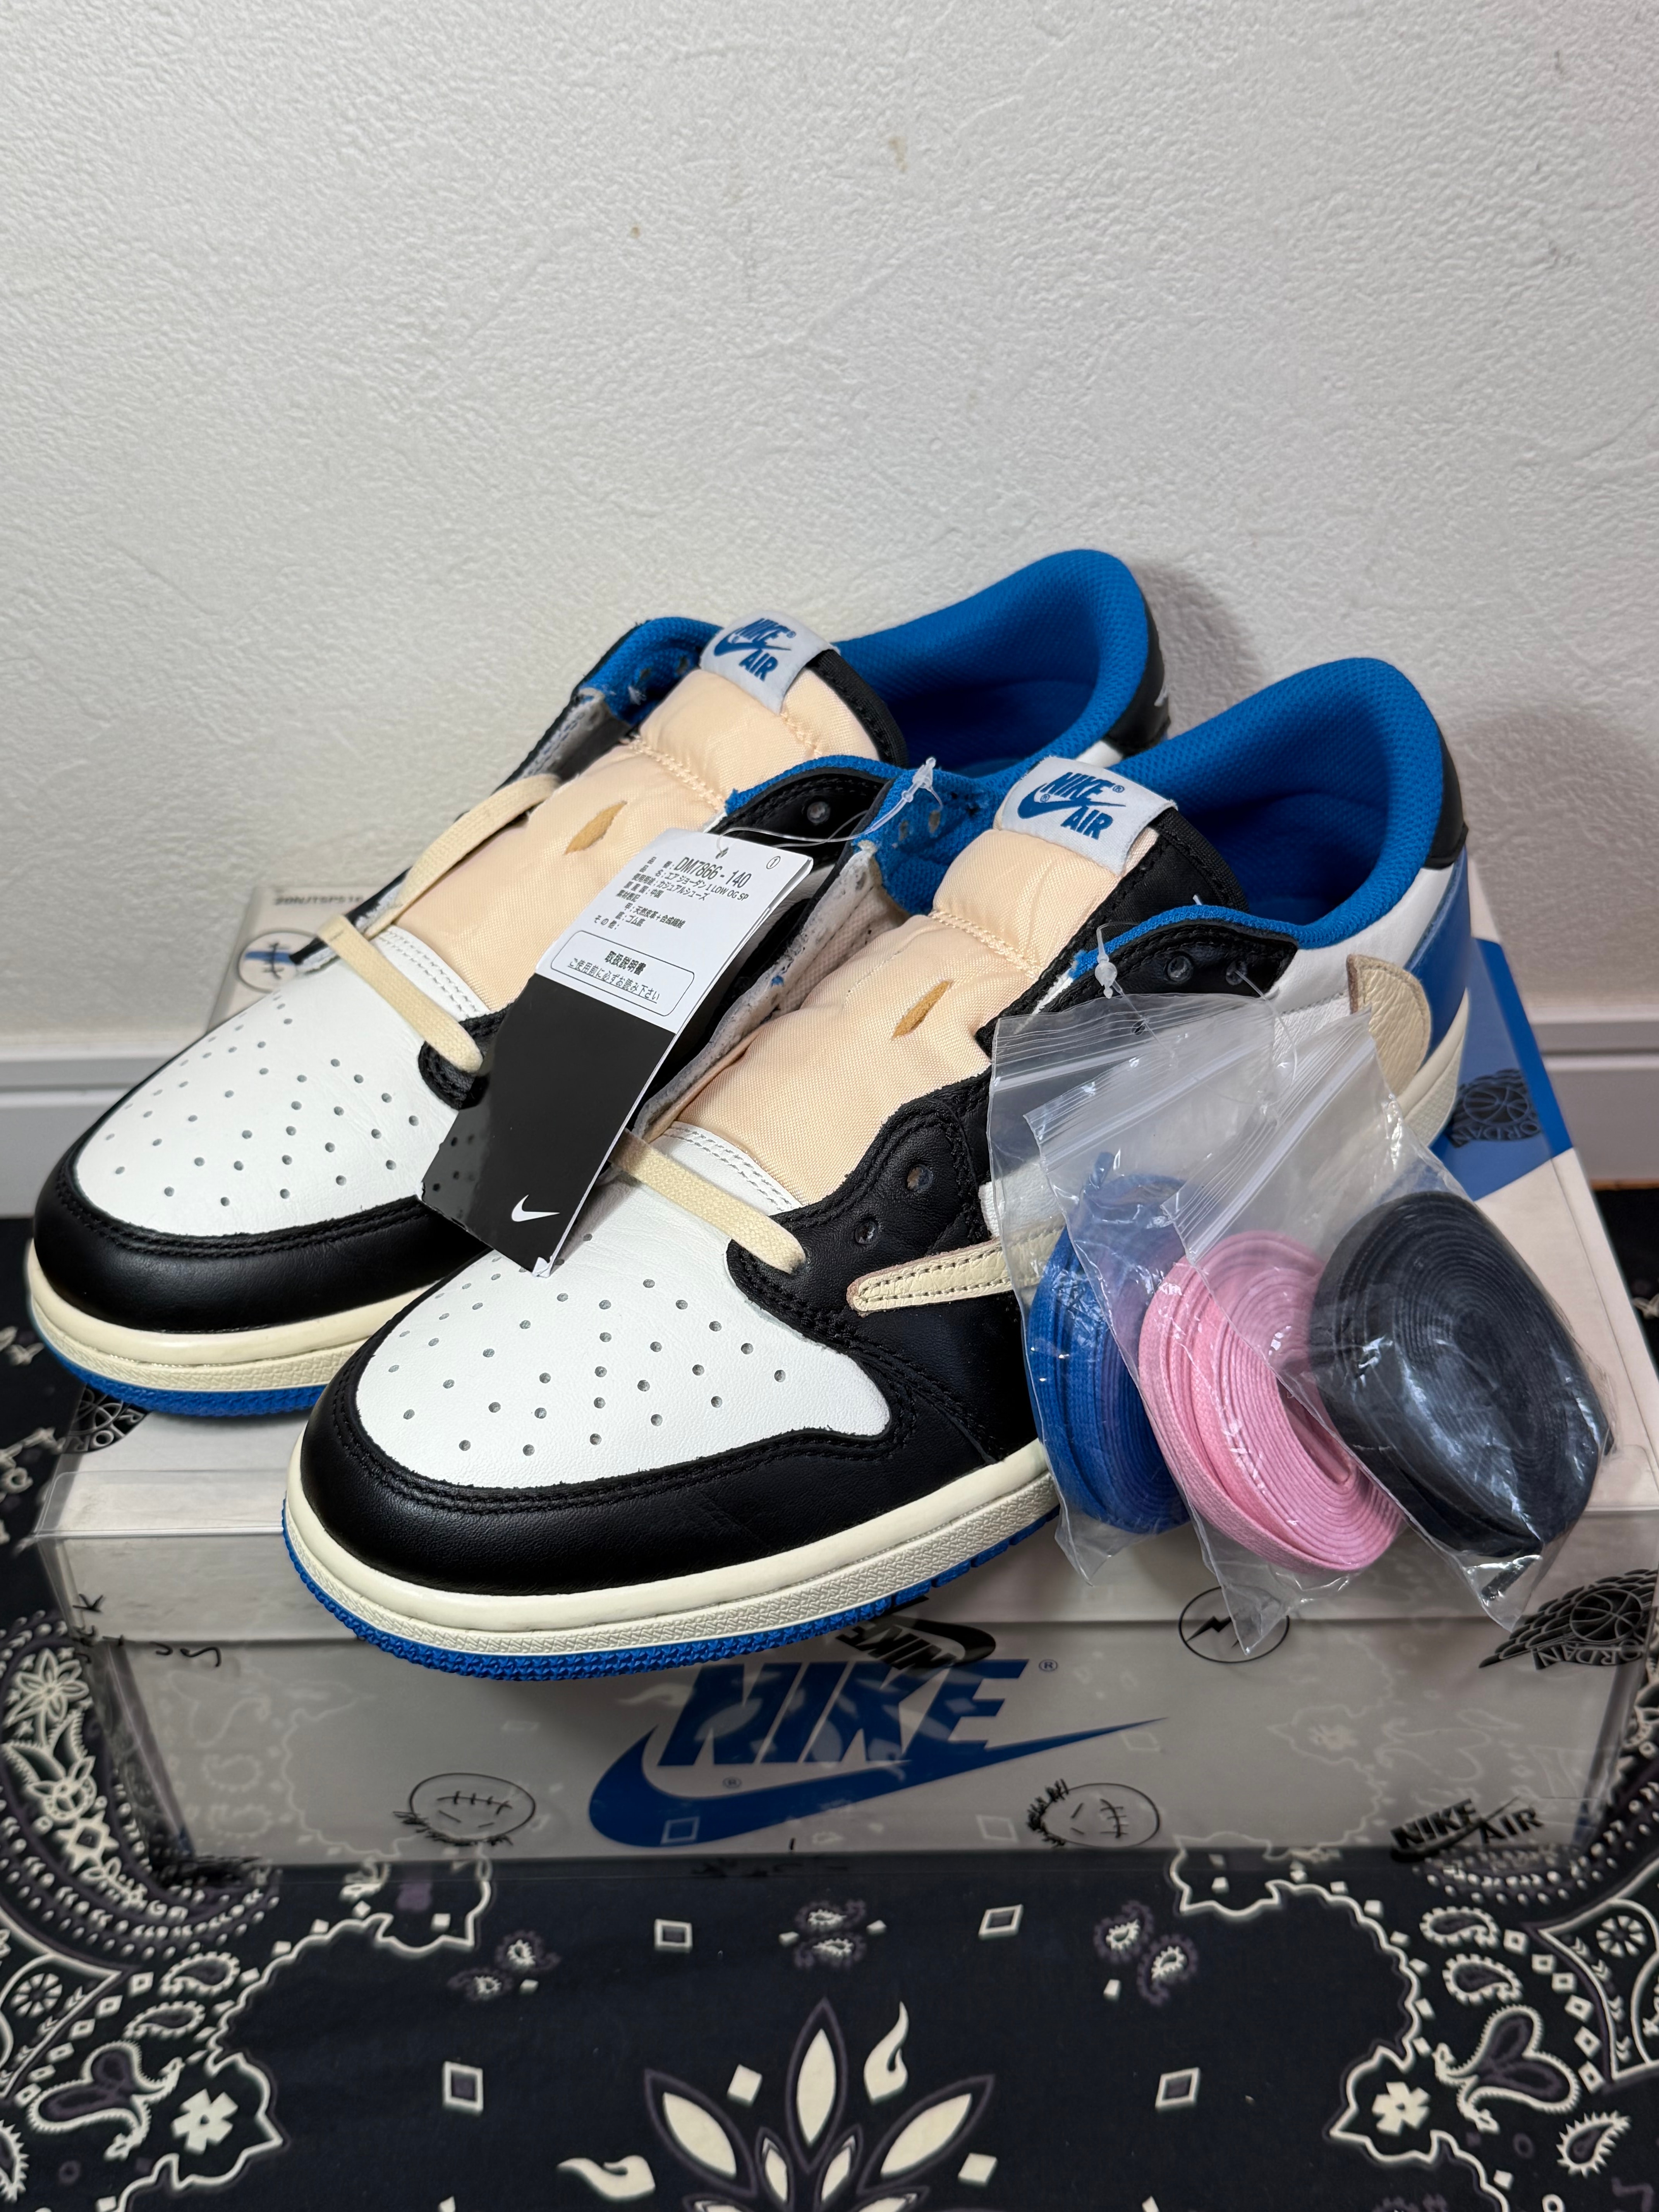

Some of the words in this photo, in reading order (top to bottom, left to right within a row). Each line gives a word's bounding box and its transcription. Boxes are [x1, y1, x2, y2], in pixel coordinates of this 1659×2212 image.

[737, 618, 790, 643] NIKE
[739, 649, 778, 681] AIR
[1040, 772, 1115, 800] NIKE
[1061, 807, 1113, 840] AIR
[605, 950, 647, 975] 取扱説明書
[657, 1659, 1030, 1766] NIKE
[1390, 1798, 1477, 1848] NIKE
[1480, 1807, 1544, 1844] AIR
